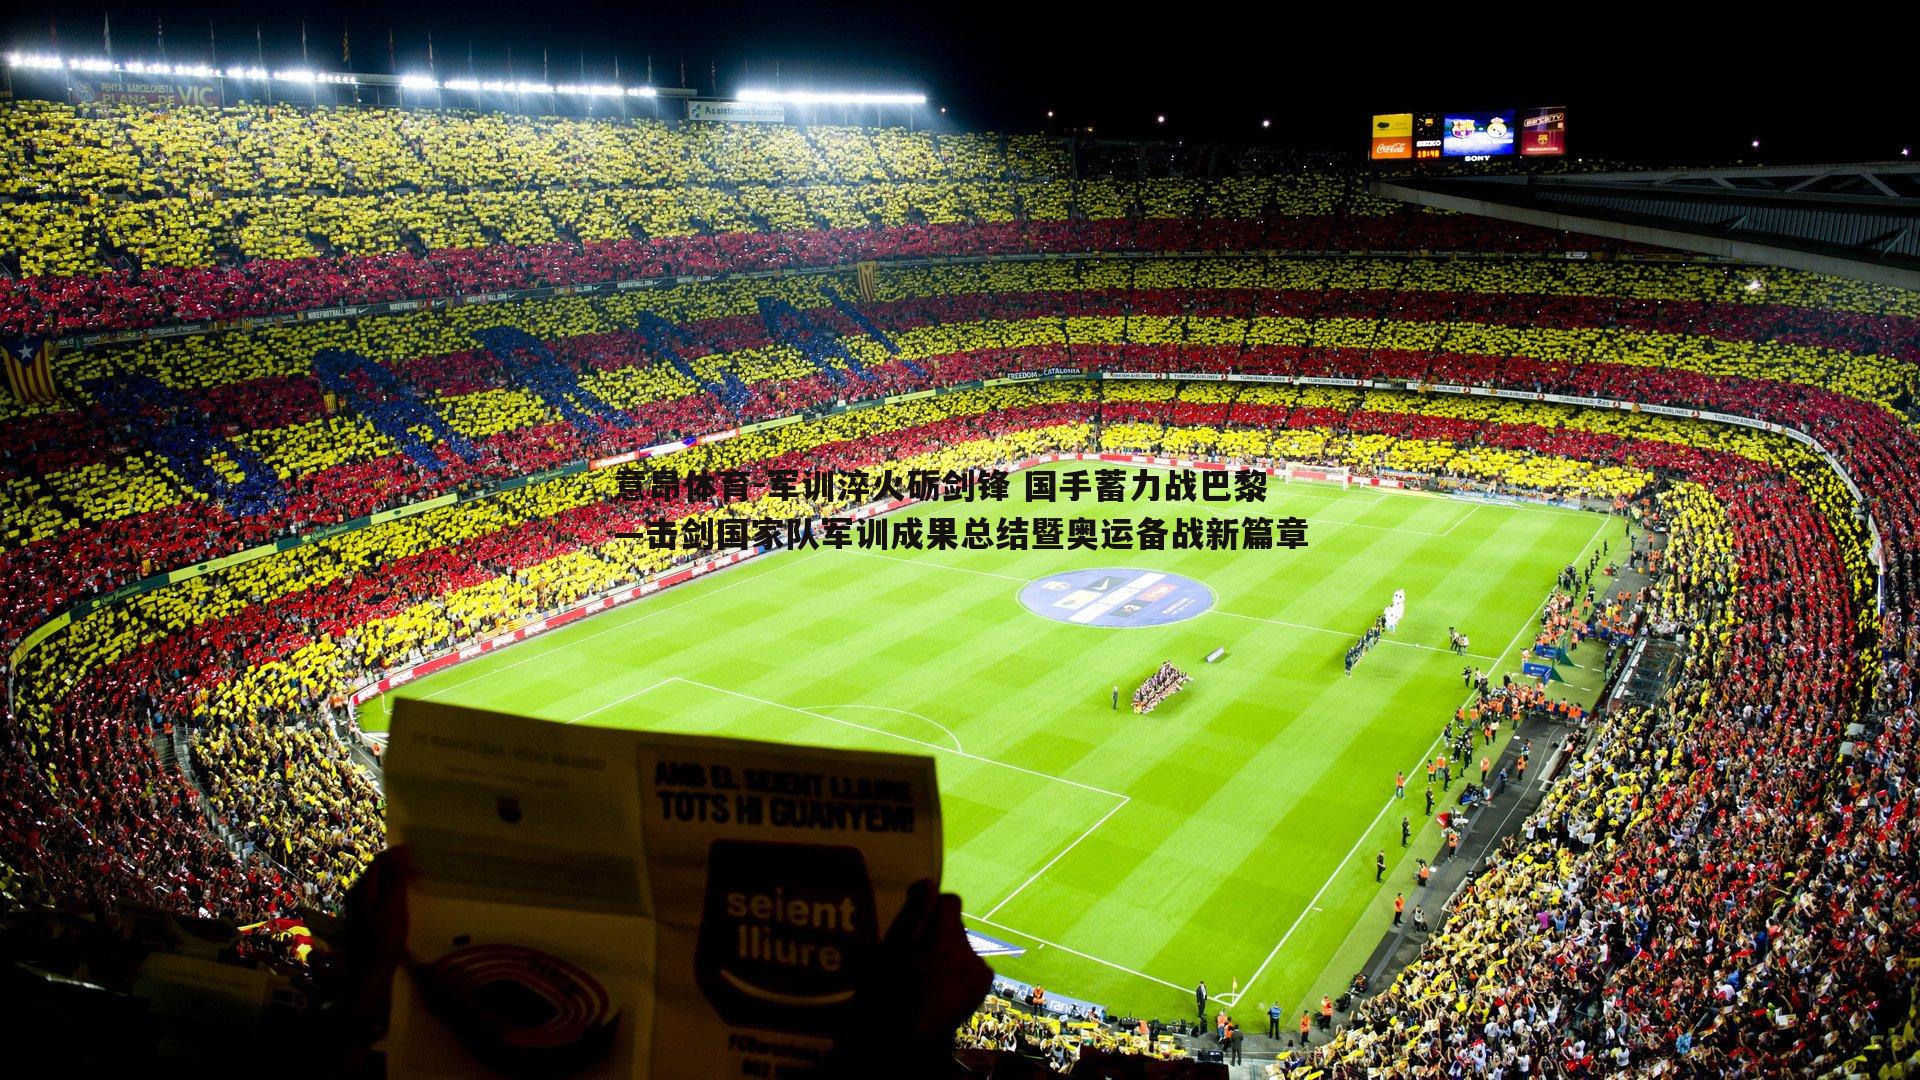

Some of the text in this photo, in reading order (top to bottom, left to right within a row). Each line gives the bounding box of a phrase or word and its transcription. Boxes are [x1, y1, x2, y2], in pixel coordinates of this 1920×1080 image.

[101, 83, 123, 92] PENYA
[177, 86, 214, 106] VIC
[307, 308, 358, 319] NIKEFOOTBALL.COM
[1007, 371, 1038, 380] FREEDOM
[1043, 367, 1081, 376] CATALONIA
[1662, 408, 1689, 416] AIRLINES
[1714, 414, 1763, 428] TURKISH AIRLINES
[654, 761, 704, 789] AMB
[711, 765, 736, 789] EL
[744, 768, 824, 796] SEIENT
[658, 791, 730, 823] TOTS
[736, 795, 763, 825] HI
[726, 885, 857, 933] seient
[738, 924, 843, 973] lliure
